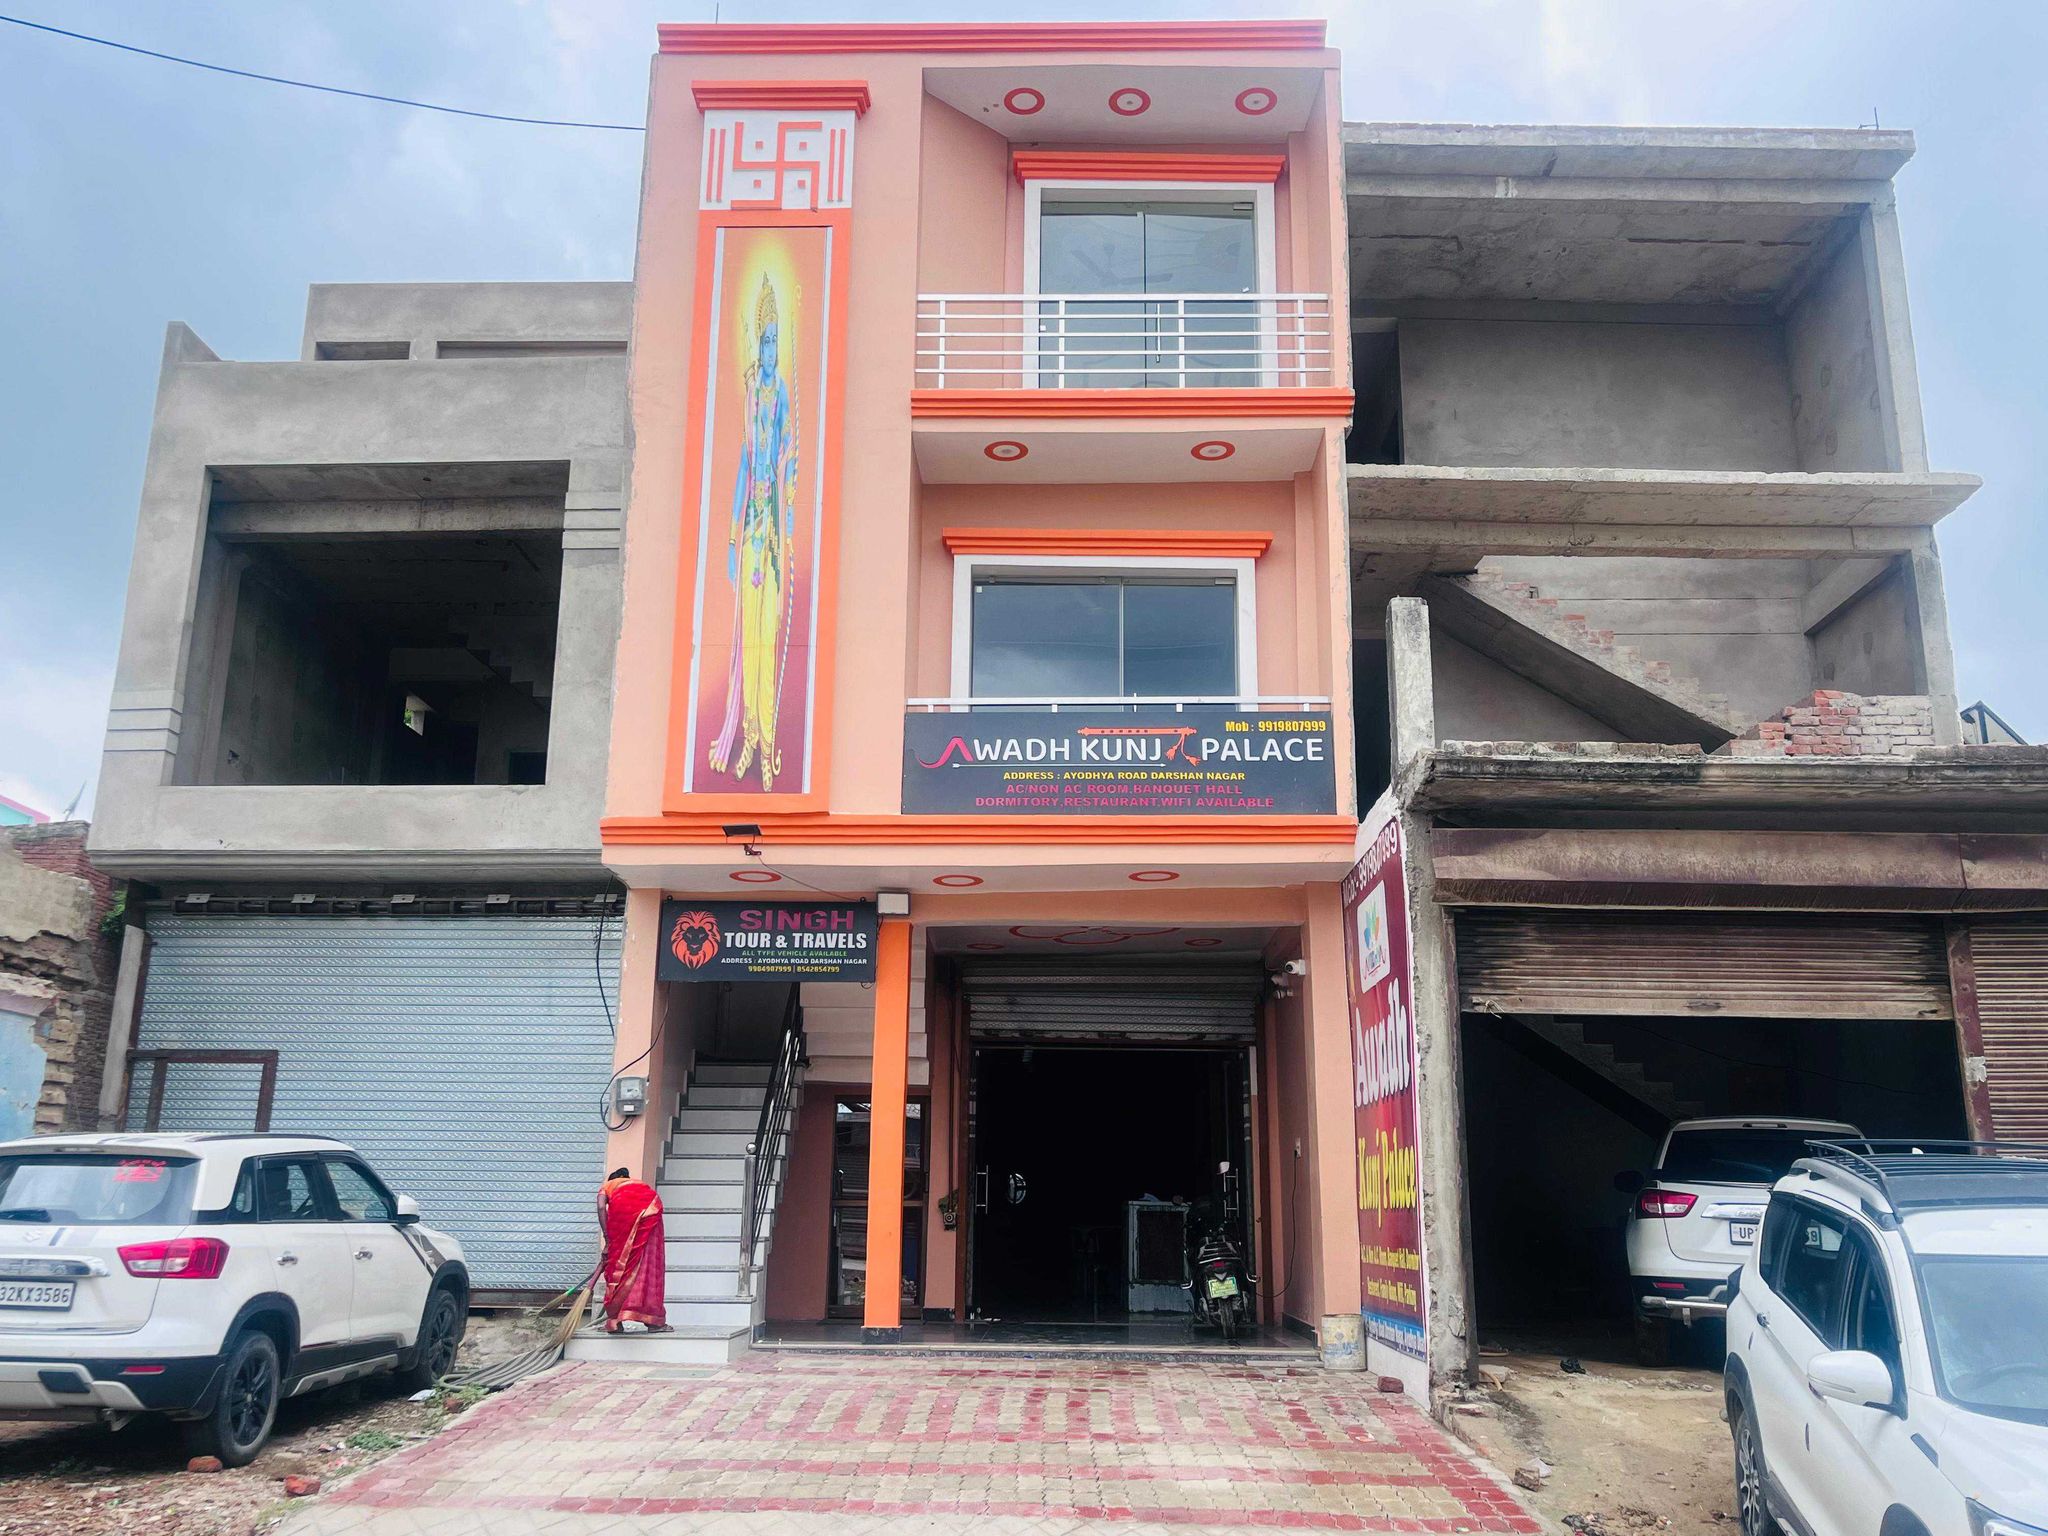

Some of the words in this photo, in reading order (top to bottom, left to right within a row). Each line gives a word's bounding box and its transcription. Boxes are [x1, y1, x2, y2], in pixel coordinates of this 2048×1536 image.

[1225, 720, 1249, 732] Mob
[1258, 720, 1326, 732] 9919807999
[913, 736, 1070, 769] AWADH
[1081, 738, 1161, 761] KUNJ
[1201, 738, 1324, 762] PALACE
[1003, 771, 1054, 781] ADDRESS
[1063, 771, 1115, 781] AYODHYA
[1118, 771, 1147, 781] ROAD
[1151, 771, 1203, 781] DARSHAN
[1206, 772, 1246, 781] NAGAR
[1006, 784, 1059, 794] AC/NON
[1063, 784, 1082, 794] AC
[1206, 784, 1243, 795] HALL
[1196, 798, 1275, 809] AVAILABLE
[739, 909, 854, 931] SINGH
[724, 932, 771, 948] TOUR
[775, 934, 788, 948] &
[792, 933, 867, 949] TRAVELS
[810, 958, 842, 966] DARSHAN
[1356, 977, 1410, 1108] Awadh
[1358, 1127, 1381, 1229] Kunj
[1381, 1126, 1417, 1210] Palace
[0, 1286, 71, 1303] 32KX3586
